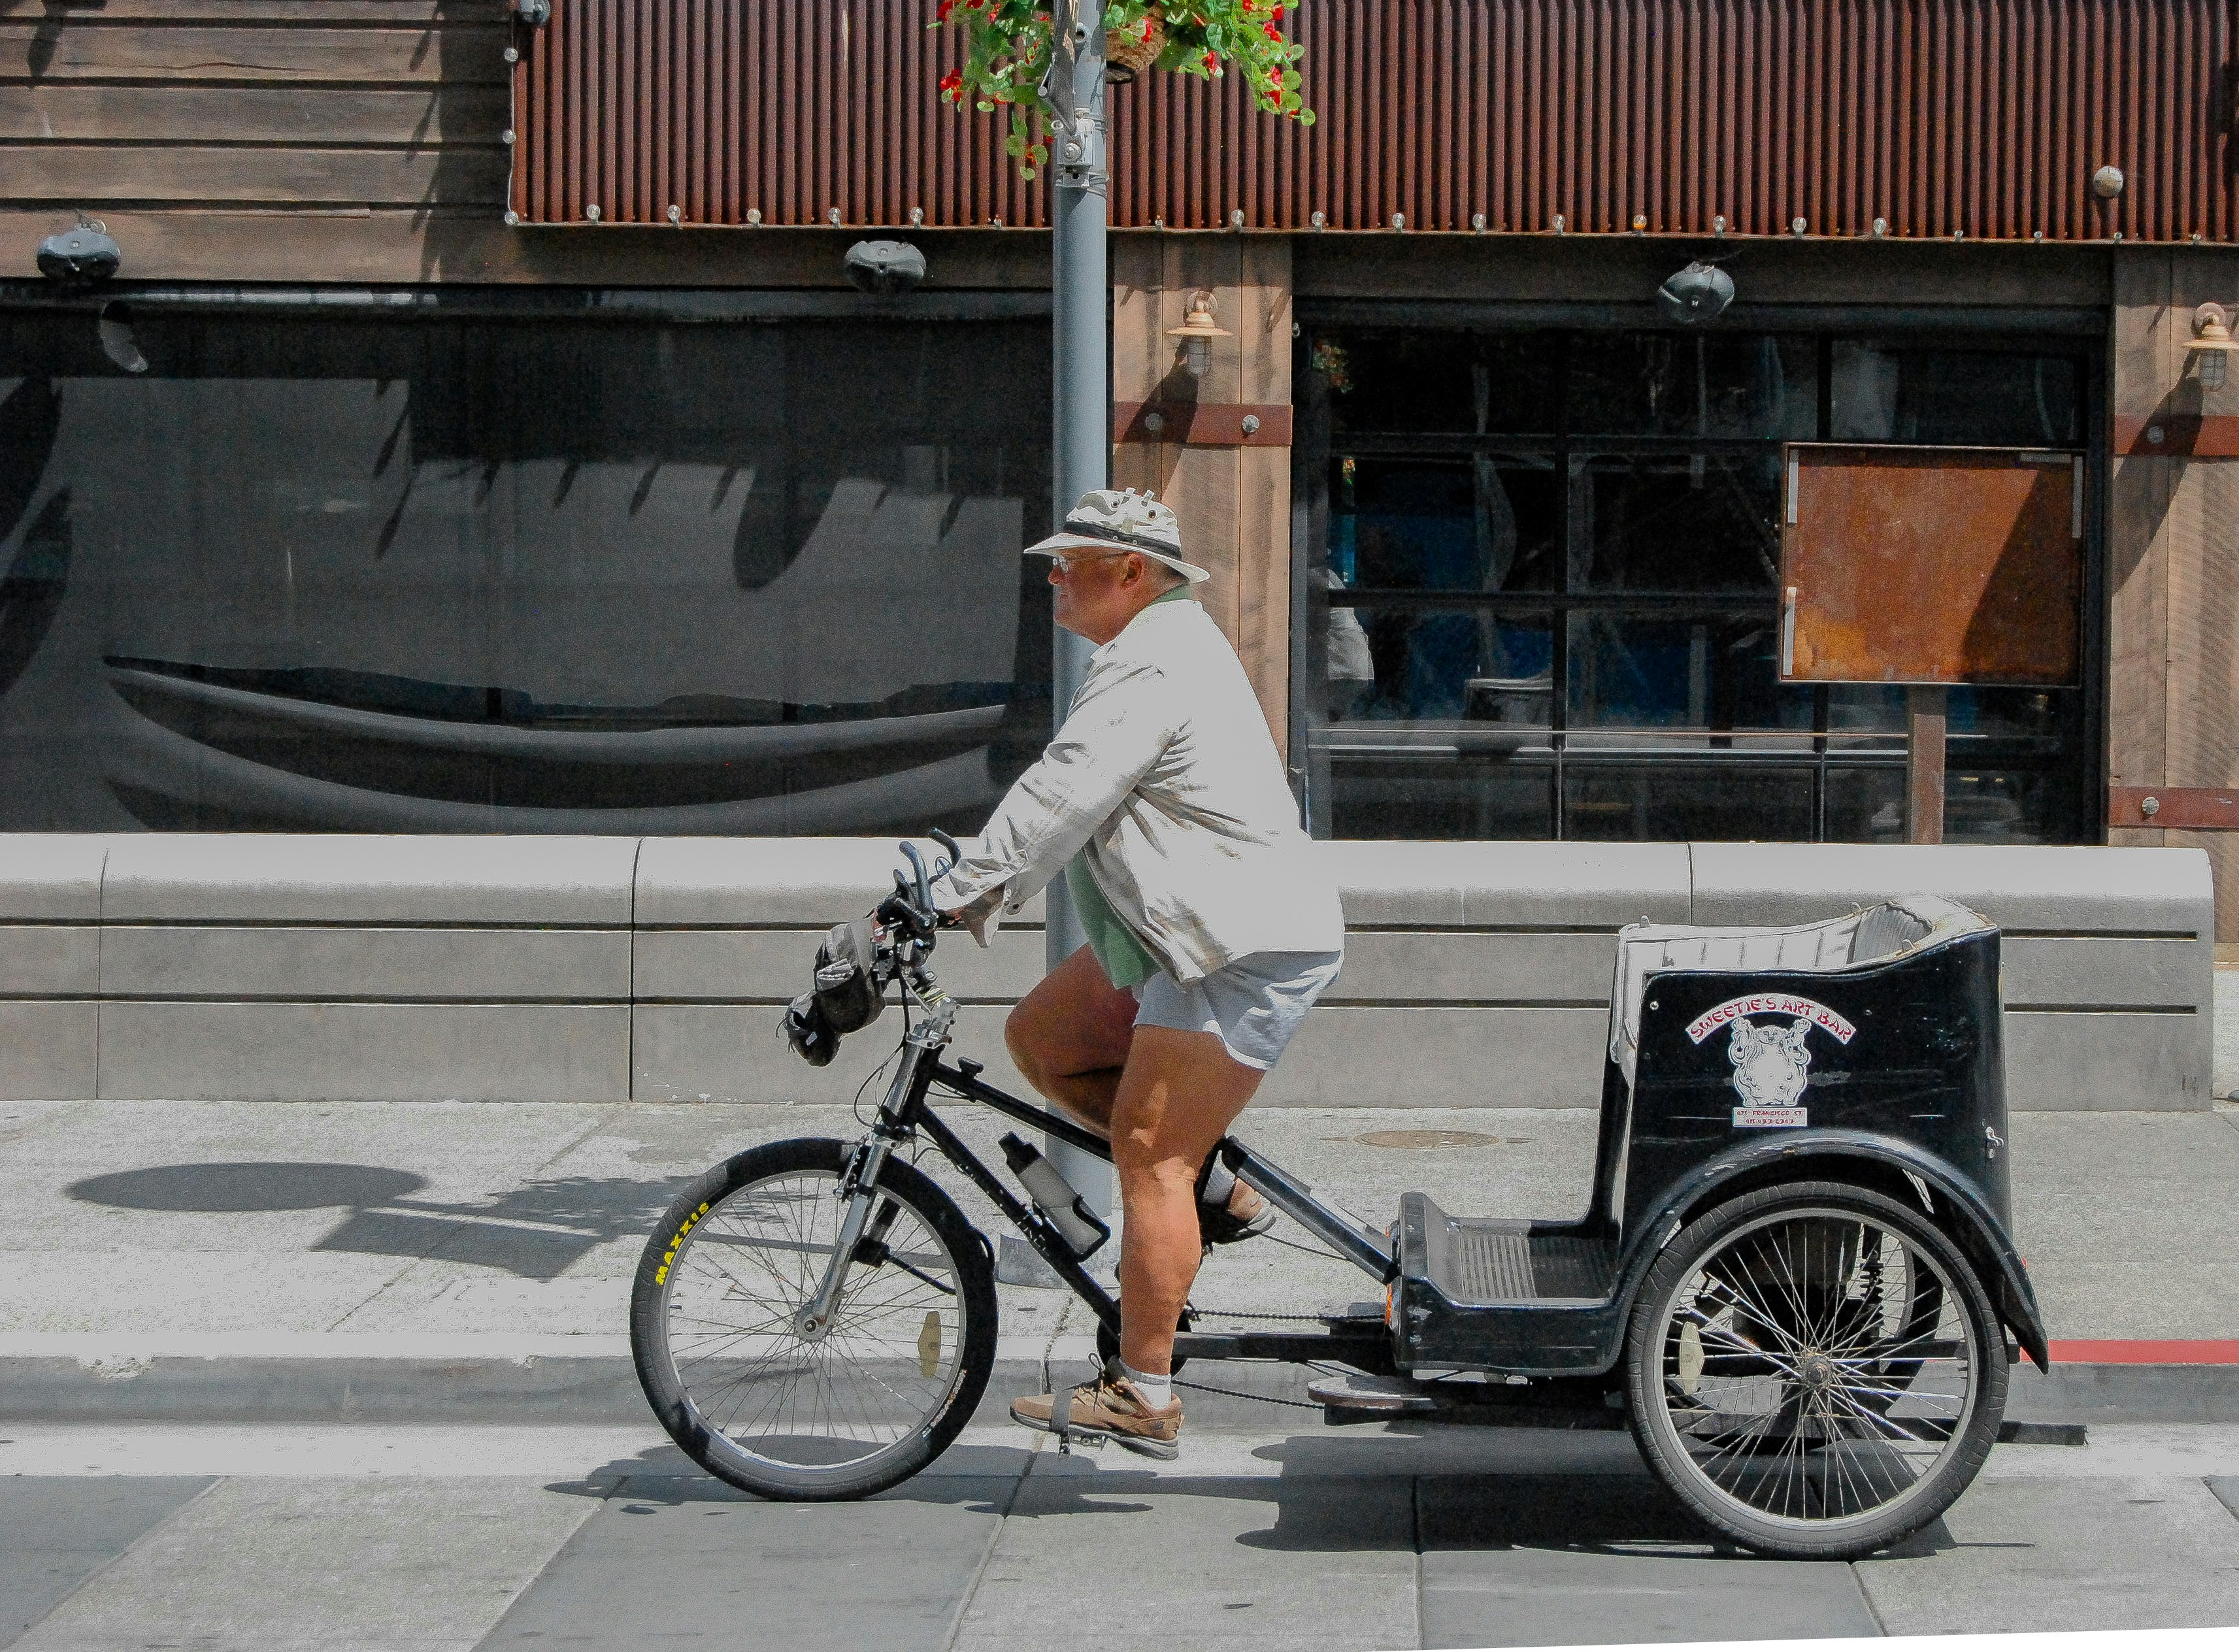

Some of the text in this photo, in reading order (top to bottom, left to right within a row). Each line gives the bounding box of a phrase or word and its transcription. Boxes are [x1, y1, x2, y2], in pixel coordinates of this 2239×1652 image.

[1691, 997, 1851, 1040] SWEETIE'S ART BAR
[655, 1202, 709, 1285] MAXXIS
